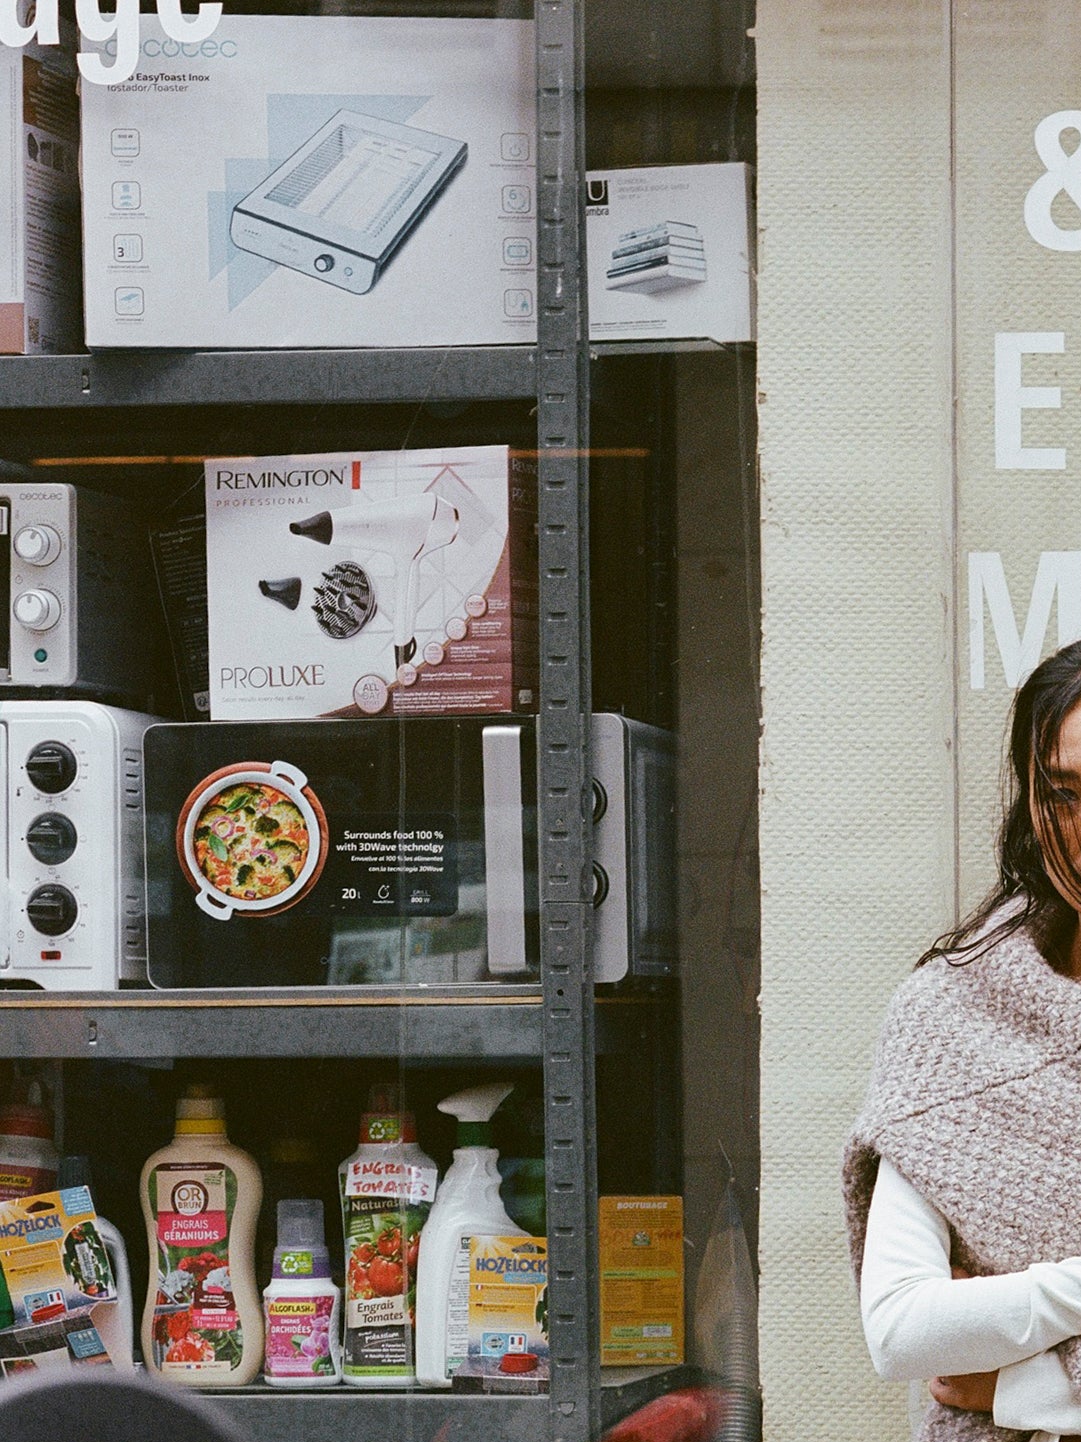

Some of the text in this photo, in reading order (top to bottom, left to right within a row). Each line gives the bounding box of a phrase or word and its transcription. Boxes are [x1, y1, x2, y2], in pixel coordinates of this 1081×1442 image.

[104, 38, 238, 58] ccotec
[136, 73, 187, 83] EasyToast
[188, 73, 210, 82] Inox
[216, 469, 345, 490] REMINGTON
[216, 497, 310, 508] PROFESSIONAL
[220, 664, 325, 689] PROLUXE
[344, 830, 444, 840] Surrounds food 100 %
[336, 842, 357, 851] with
[359, 842, 397, 851] 3DWave
[341, 888, 357, 899] 20
[353, 1161, 422, 1179] ENGRAIS
[177, 1187, 201, 1201] OR
[353, 1180, 429, 1196] TOMATES
[177, 1201, 201, 1209] BRUN
[0, 1214, 62, 1239] HOZELOCK
[171, 1219, 209, 1229] ENGRAIS
[164, 1229, 219, 1241] GÉRANIUMS
[476, 1256, 547, 1274] HOZELOCK
[269, 1304, 311, 1313] ALGOFLASH
[357, 1300, 394, 1315] Engrais
[362, 1311, 404, 1323] Tomates
[270, 1323, 312, 1334] ORCHIDÉES
